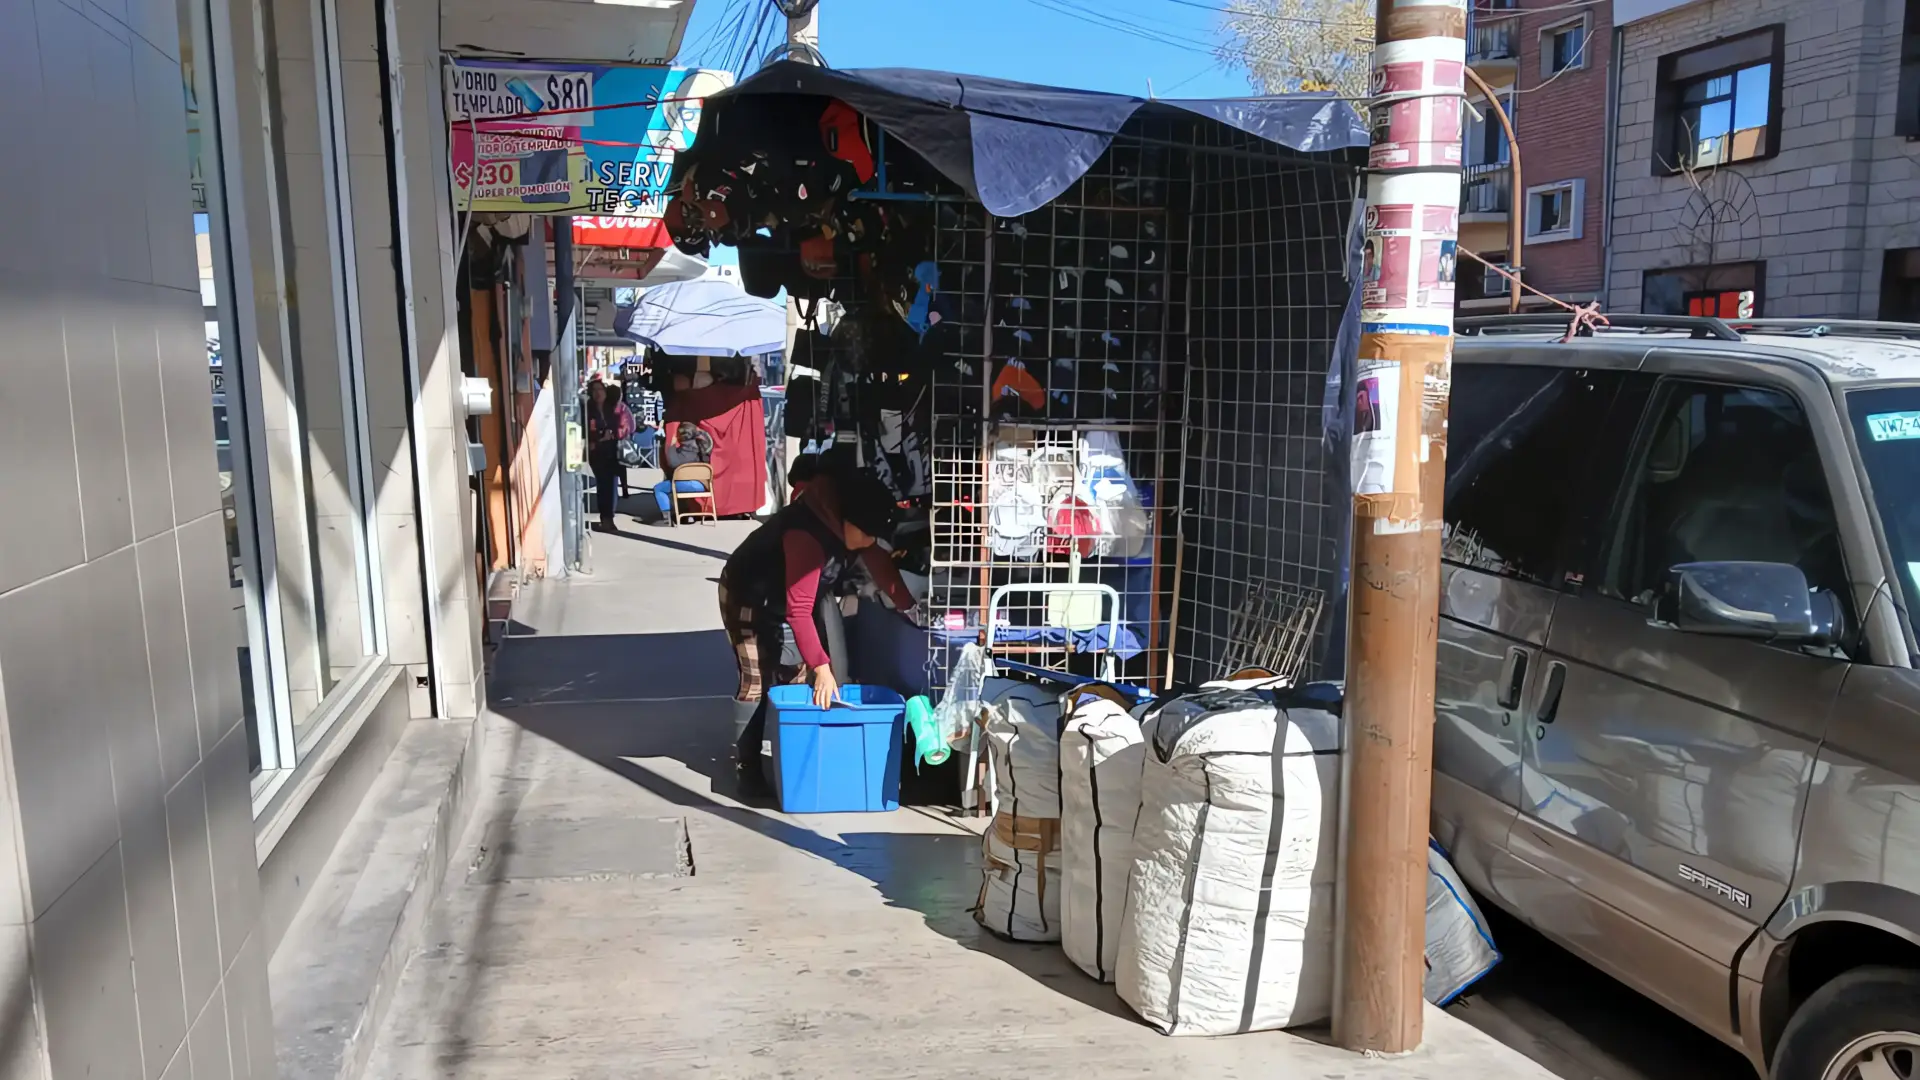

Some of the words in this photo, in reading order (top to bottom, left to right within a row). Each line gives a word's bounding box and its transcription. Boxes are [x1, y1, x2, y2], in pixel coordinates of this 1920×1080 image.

[452, 92, 524, 114] TEMPLADO
[547, 74, 589, 110] $80
[477, 140, 513, 154] IDRIO
[455, 163, 514, 190] $230
[599, 160, 672, 187] SERV
[474, 187, 504, 198] UPER
[1679, 864, 1751, 909] SAFARI
